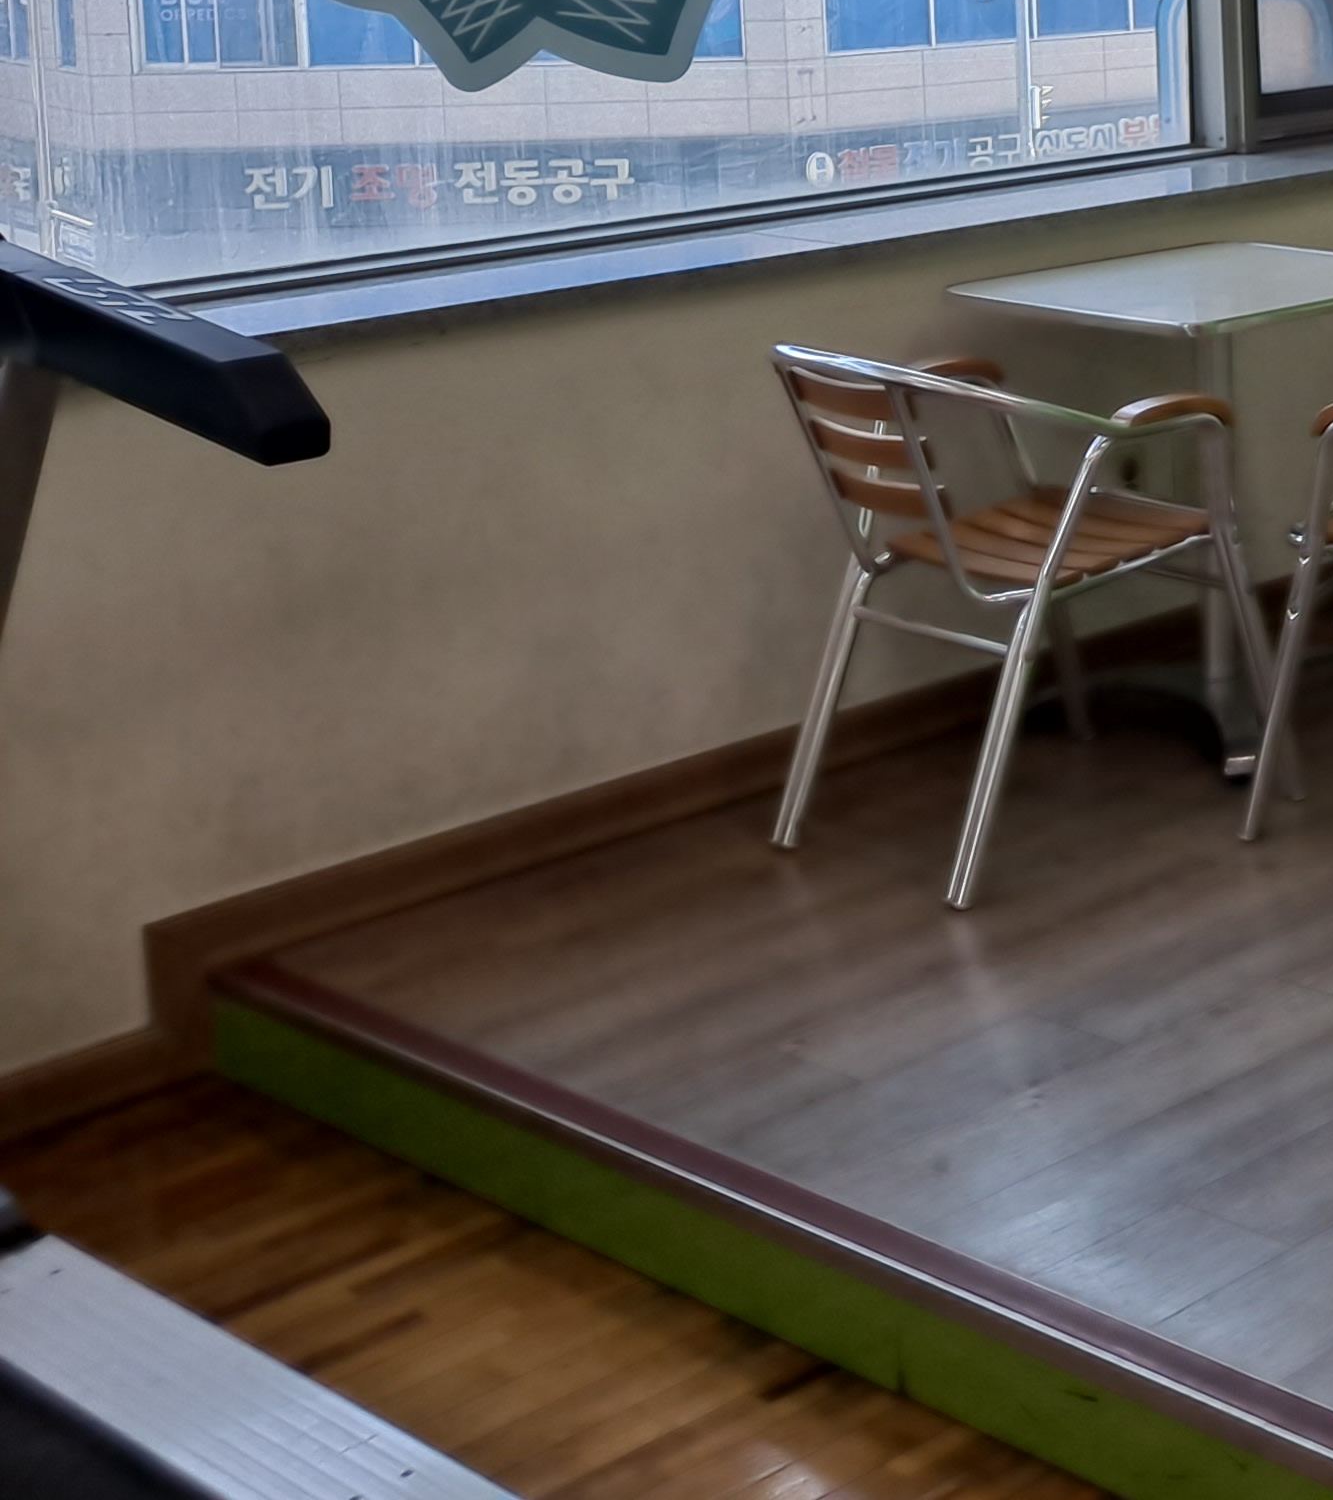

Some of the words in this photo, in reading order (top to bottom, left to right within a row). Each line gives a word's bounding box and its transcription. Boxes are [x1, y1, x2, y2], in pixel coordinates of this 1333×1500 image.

[967, 131, 1024, 169] 공구
[244, 164, 335, 211] 전기
[349, 163, 438, 210] 조명
[453, 157, 636, 207] 전동공구
